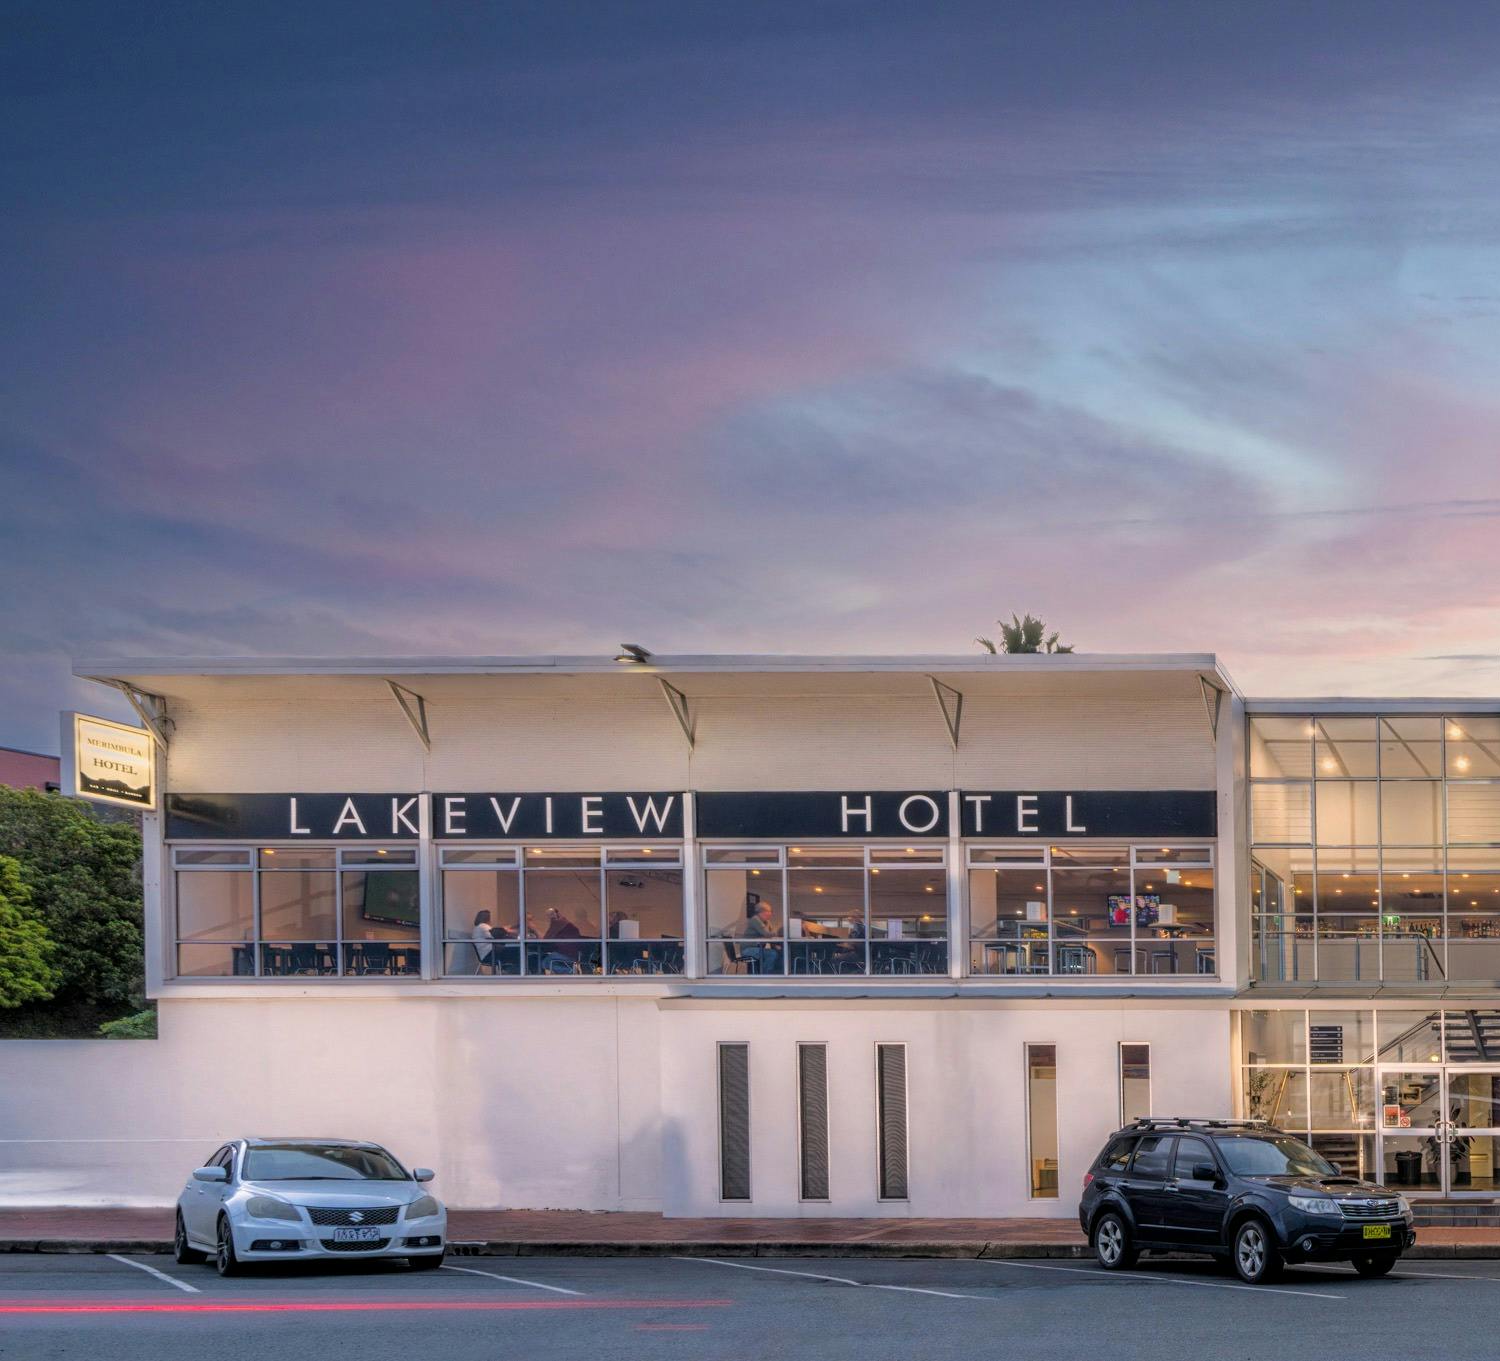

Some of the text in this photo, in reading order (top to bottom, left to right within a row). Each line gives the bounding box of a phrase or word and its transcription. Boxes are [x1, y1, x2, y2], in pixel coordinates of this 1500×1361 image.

[87, 738, 143, 757] MERIMBULA
[93, 758, 138, 776] HOTEL
[290, 795, 1087, 835] LAKEVIEW HOTEL
